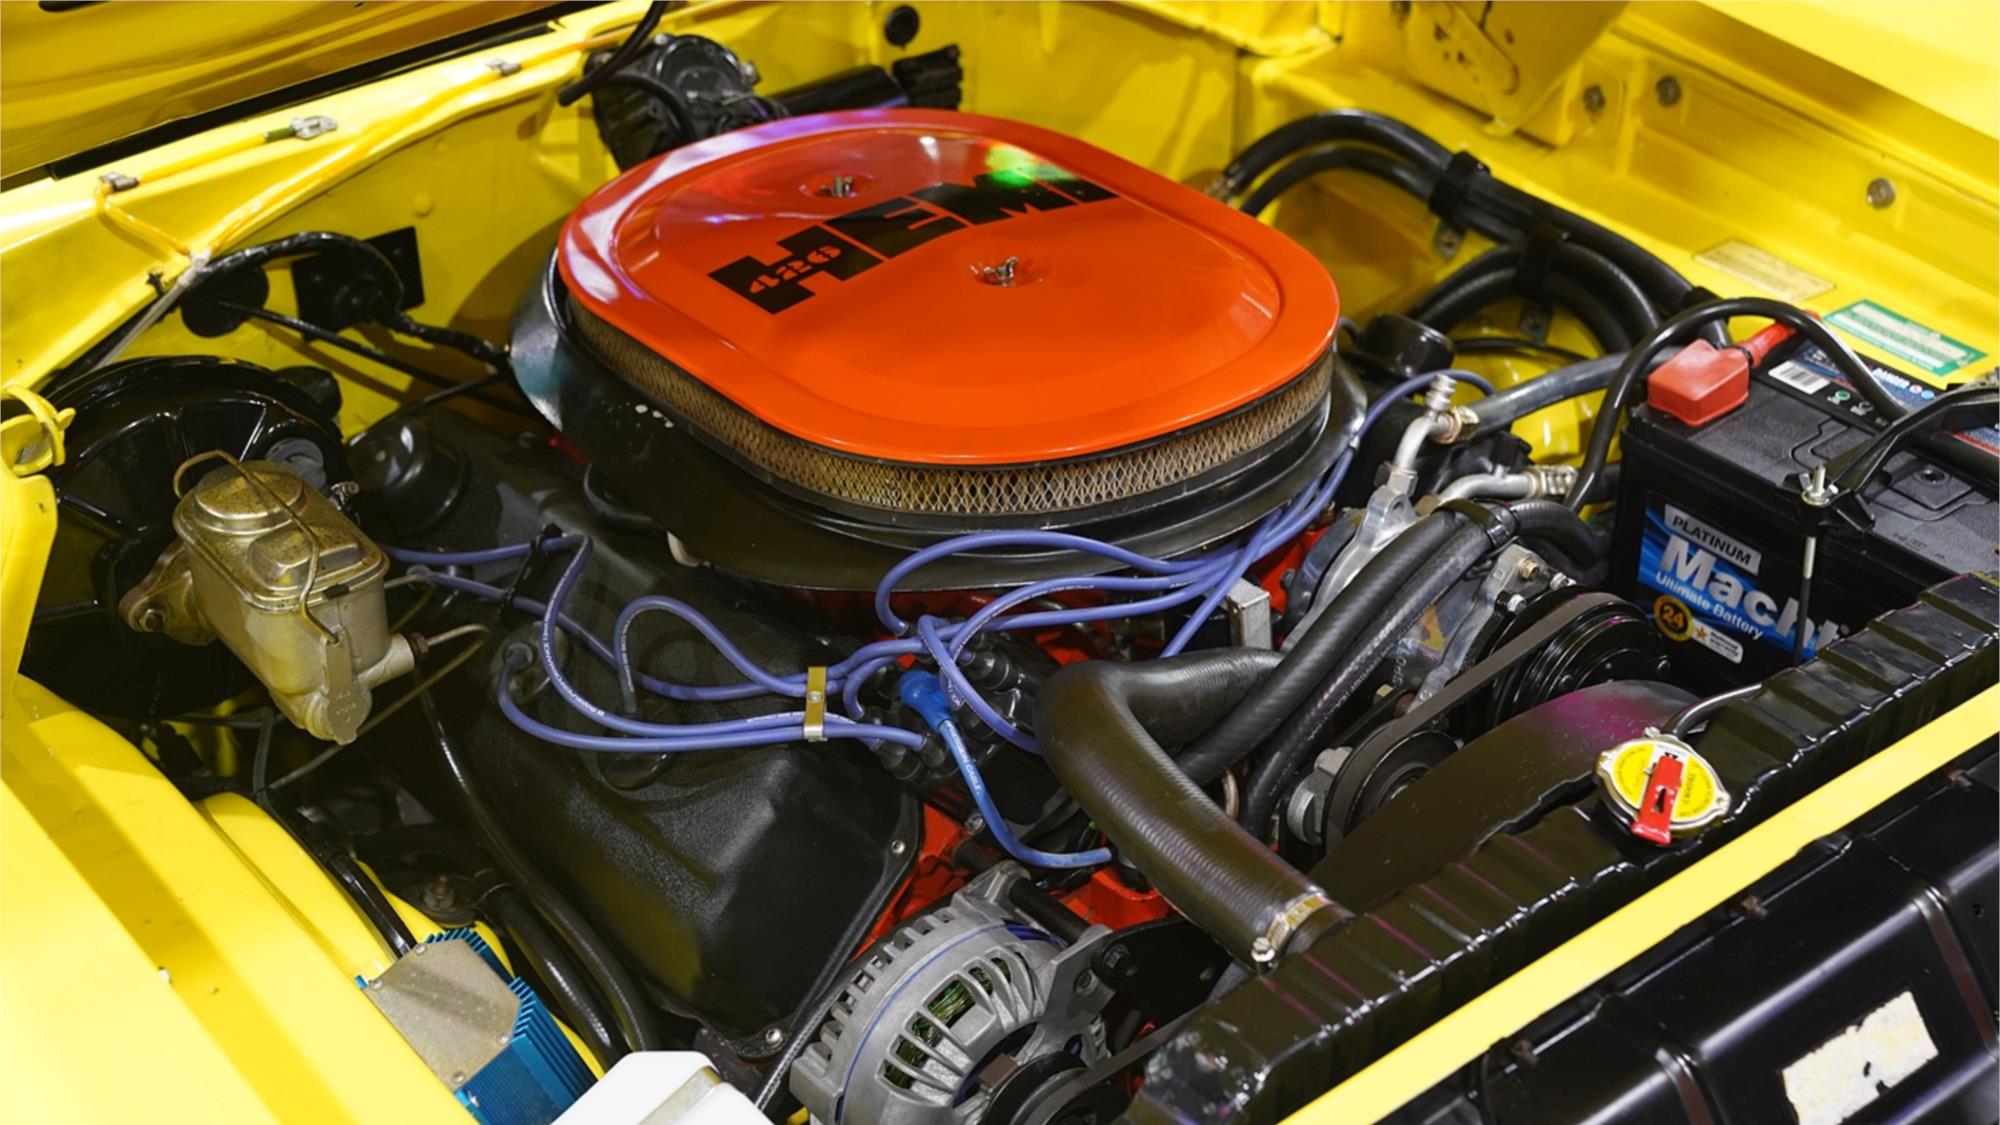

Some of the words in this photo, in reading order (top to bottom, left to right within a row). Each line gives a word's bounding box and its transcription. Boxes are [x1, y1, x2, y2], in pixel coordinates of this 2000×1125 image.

[707, 169, 1120, 315] HEMI
[749, 245, 843, 294] 426
[1672, 515, 1752, 566] PLATINUM
[1655, 571, 1711, 611] Ultimate
[1660, 604, 1686, 629] 24
[1713, 603, 1764, 640] Battery
